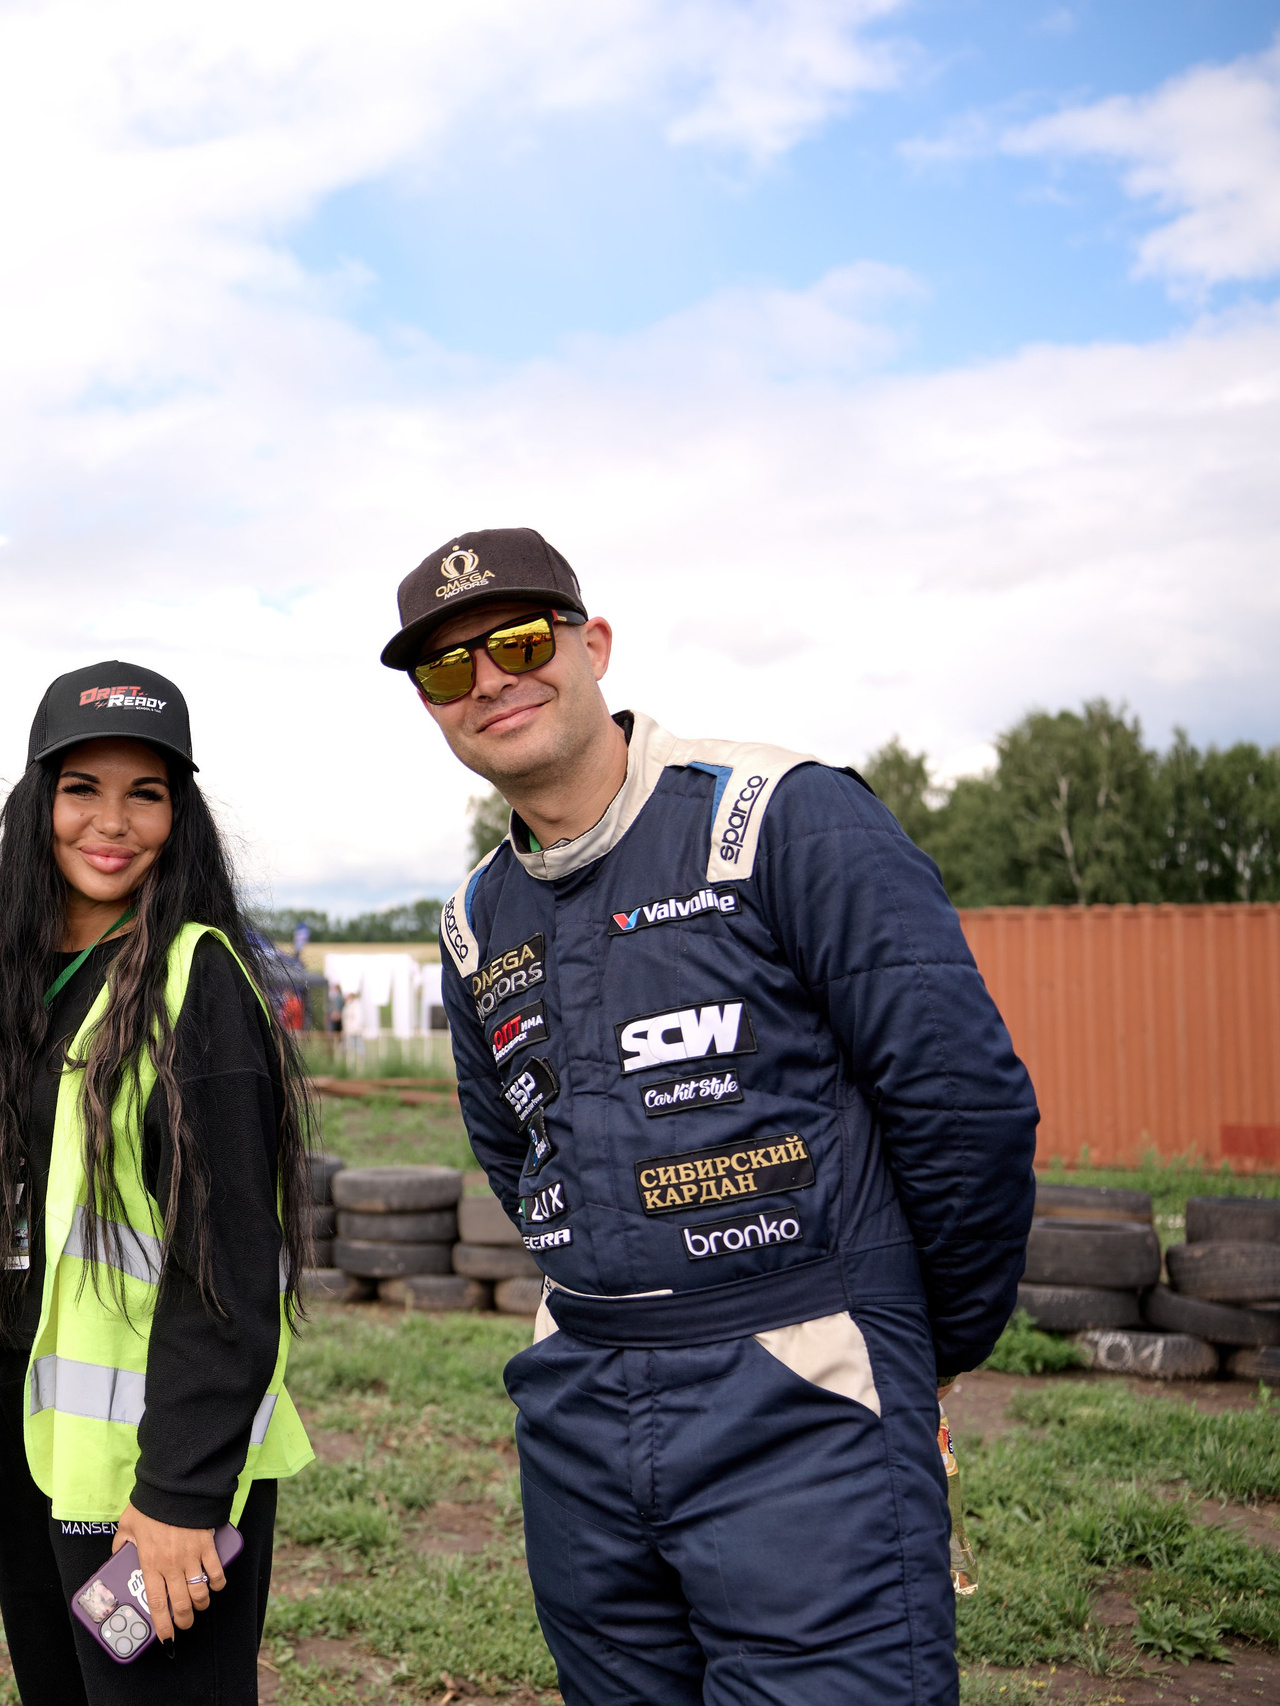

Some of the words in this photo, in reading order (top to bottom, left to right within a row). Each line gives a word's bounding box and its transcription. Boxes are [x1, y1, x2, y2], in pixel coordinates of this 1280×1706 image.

[435, 570, 496, 598] OMEGA
[444, 579, 489, 600] MOTORS
[79, 685, 141, 706] DRIFT
[107, 694, 167, 710] READY
[718, 775, 763, 862] sparco
[621, 1002, 743, 1072] SCW
[504, 1071, 536, 1114] SSP
[698, 1073, 739, 1100] Style
[640, 1135, 808, 1188] СИБИРСКИЙ
[642, 1172, 759, 1210] КАРДАН
[683, 1214, 801, 1257] bronko
